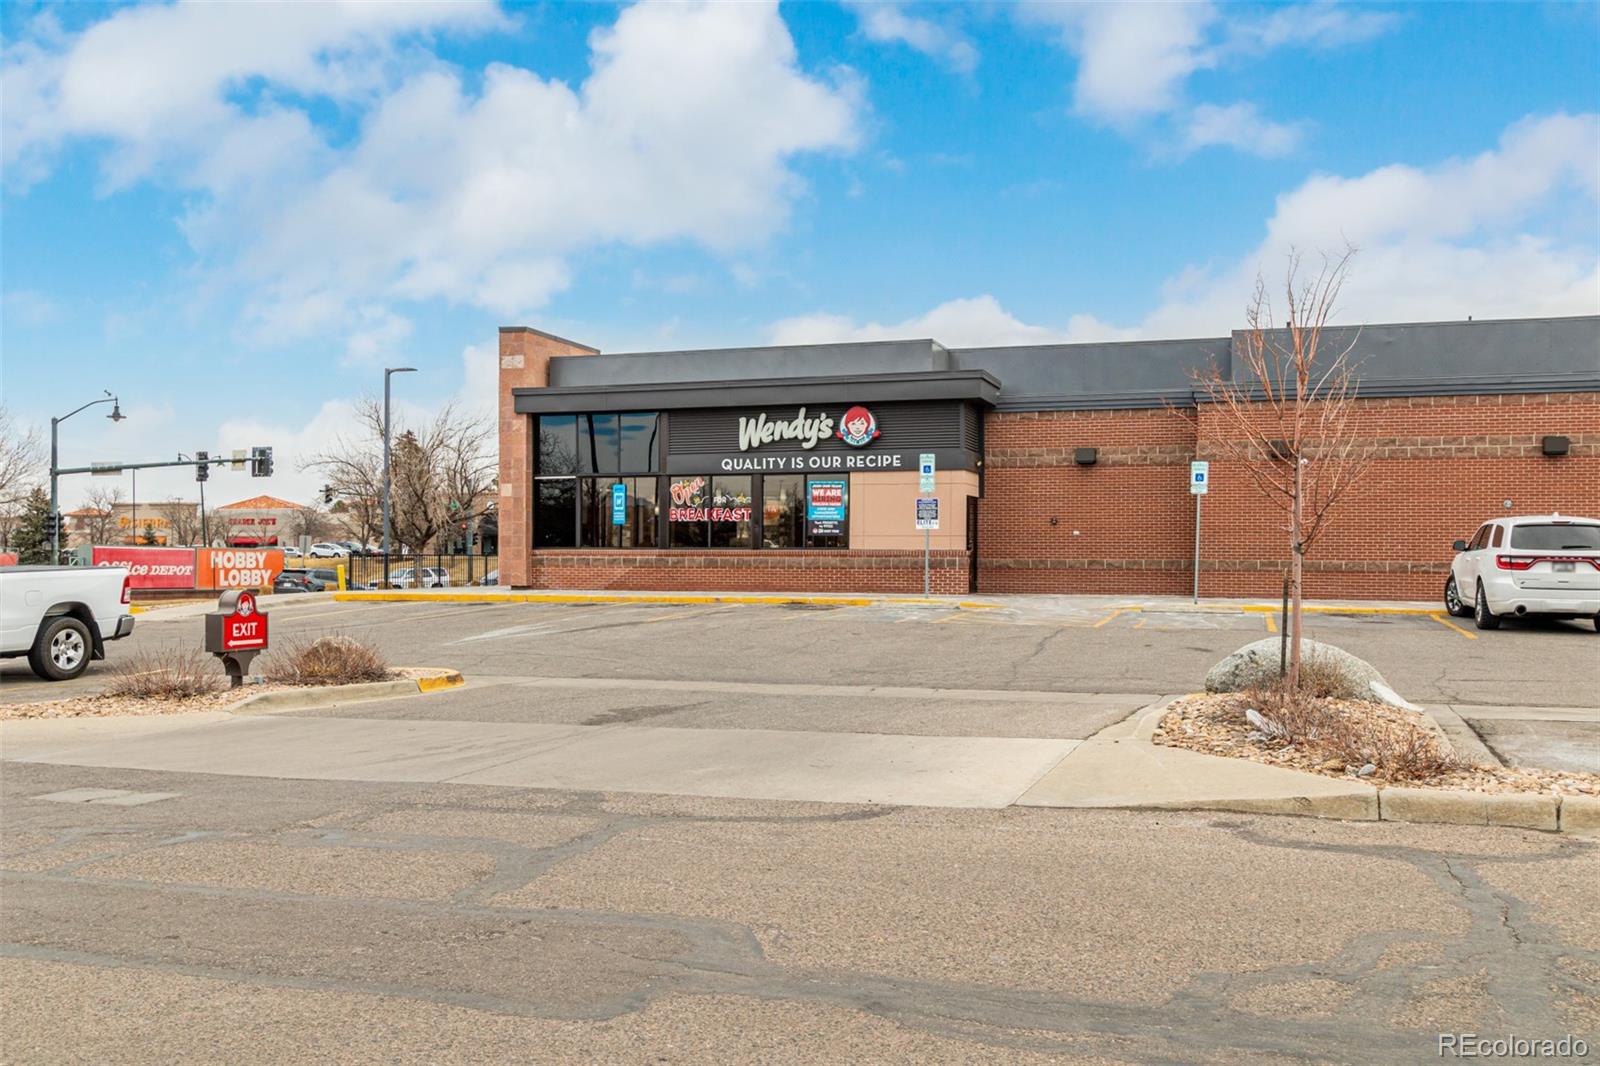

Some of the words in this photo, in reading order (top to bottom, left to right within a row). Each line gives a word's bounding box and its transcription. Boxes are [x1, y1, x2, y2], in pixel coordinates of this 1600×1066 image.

[738, 406, 834, 451] Wendy's
[721, 457, 786, 471] QUALITY
[791, 456, 804, 469] IS
[809, 455, 841, 469] OUR
[846, 455, 902, 468] RECIPE
[669, 507, 752, 522] BREAKFAST
[210, 551, 267, 569] HOBBY
[149, 565, 193, 575] DEPOT
[219, 569, 272, 587] LOBBY
[232, 622, 258, 637] EXIT
